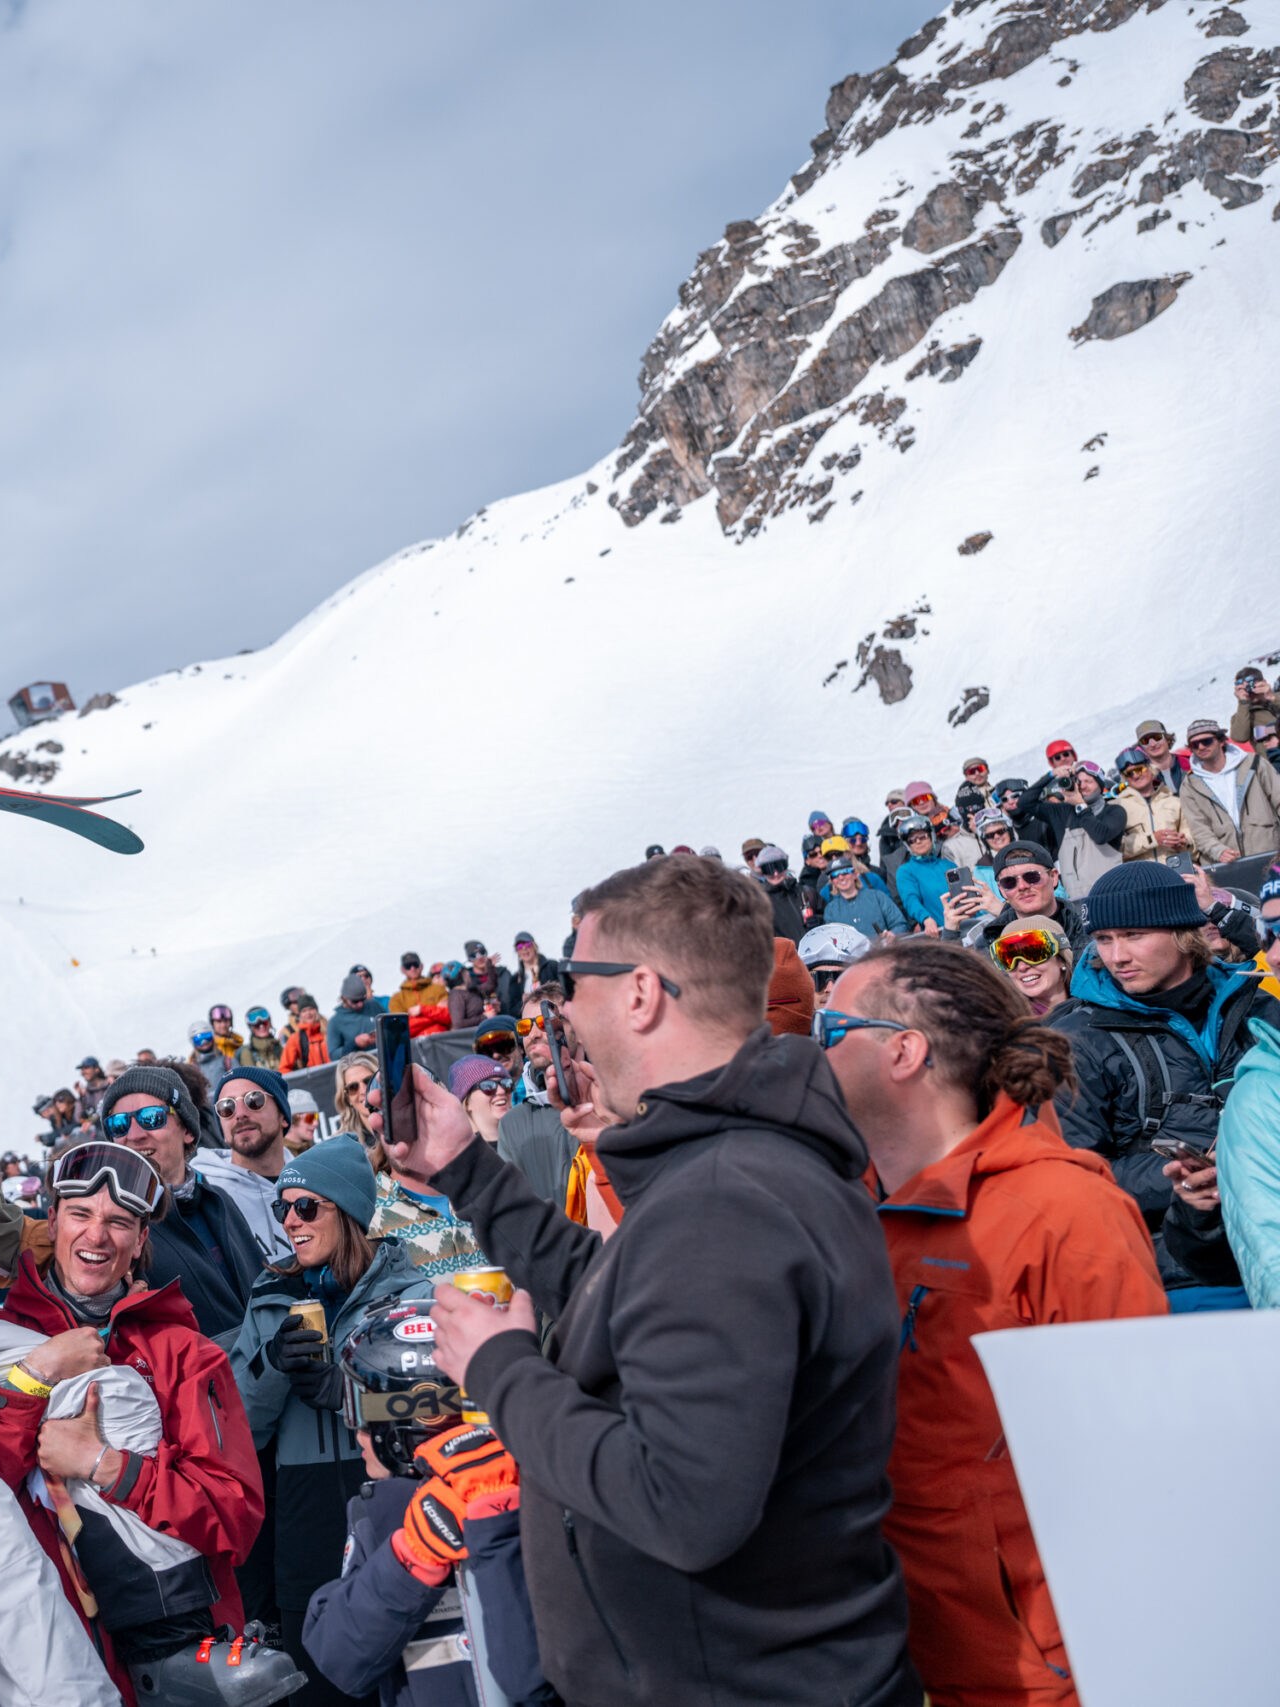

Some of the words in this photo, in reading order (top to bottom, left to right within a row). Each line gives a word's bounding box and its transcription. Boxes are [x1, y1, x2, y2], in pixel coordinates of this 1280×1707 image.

[403, 1322, 434, 1335] BEL
[386, 1389, 462, 1418] OAK
[422, 1500, 462, 1547] reusch
